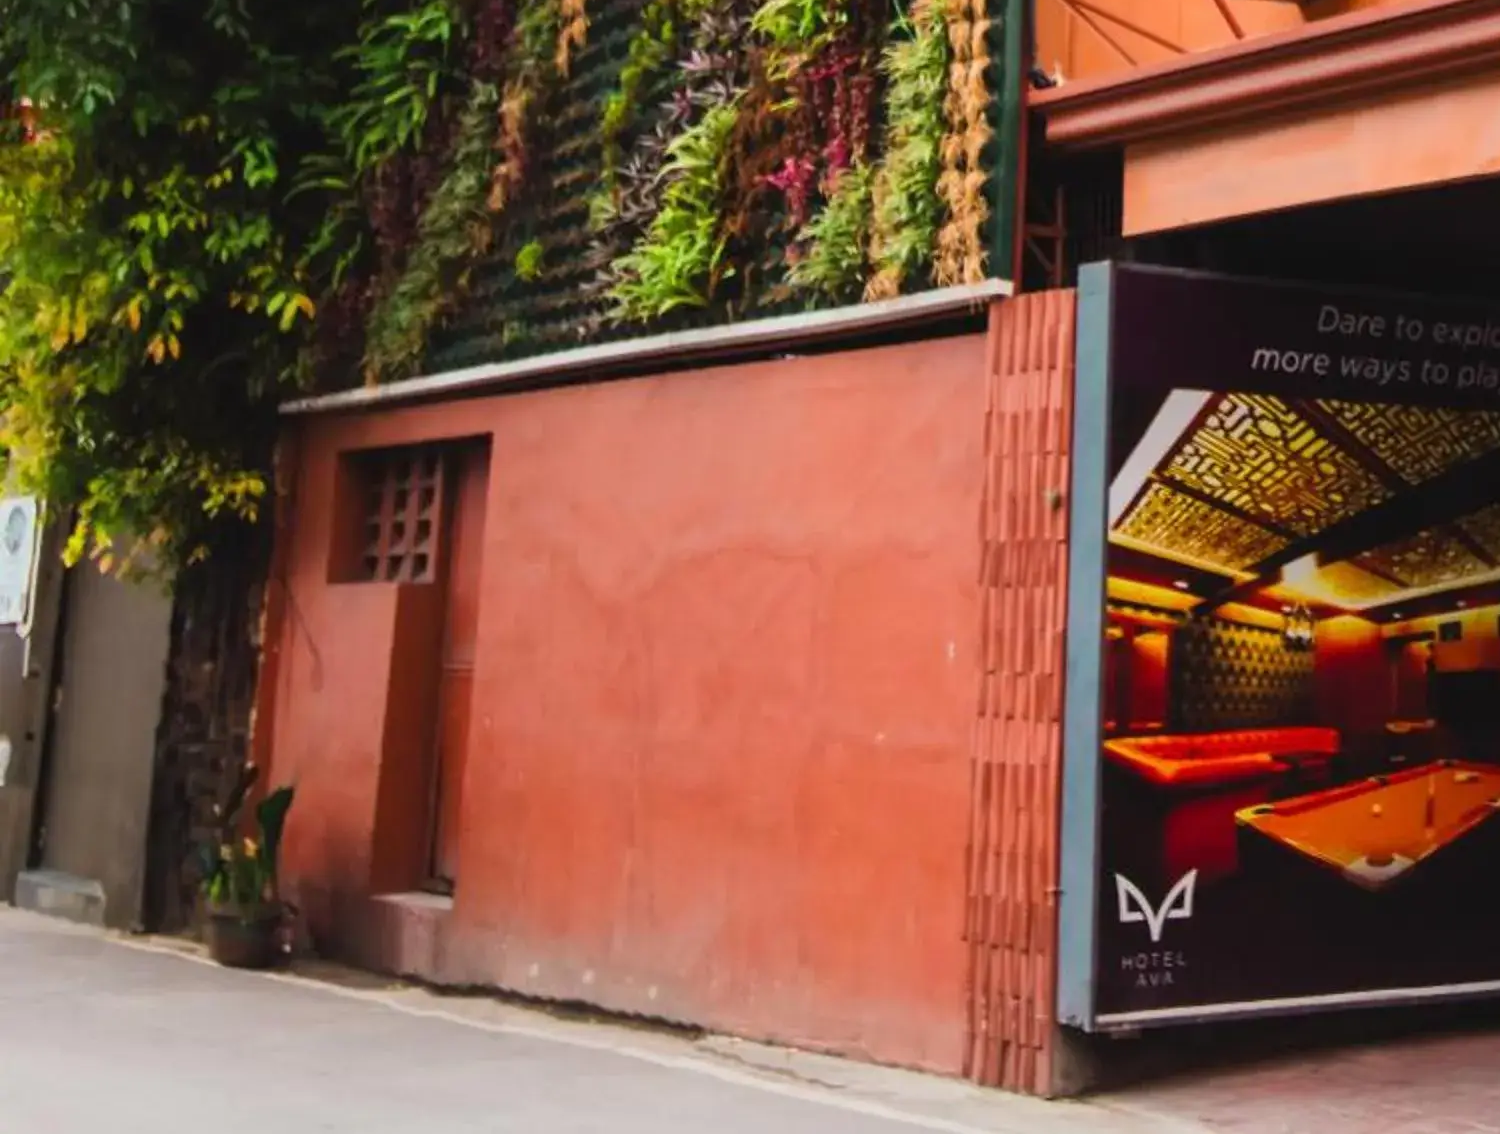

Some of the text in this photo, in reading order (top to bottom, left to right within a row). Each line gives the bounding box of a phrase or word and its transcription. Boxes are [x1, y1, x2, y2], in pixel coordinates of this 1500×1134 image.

[1317, 305, 1386, 337] Dare
[1396, 315, 1424, 341] to
[1251, 346, 1330, 376] more
[1340, 355, 1411, 385] ways
[1421, 359, 1449, 384] to
[1121, 951, 1187, 970] HOTEL
[1135, 971, 1175, 987] AVA
